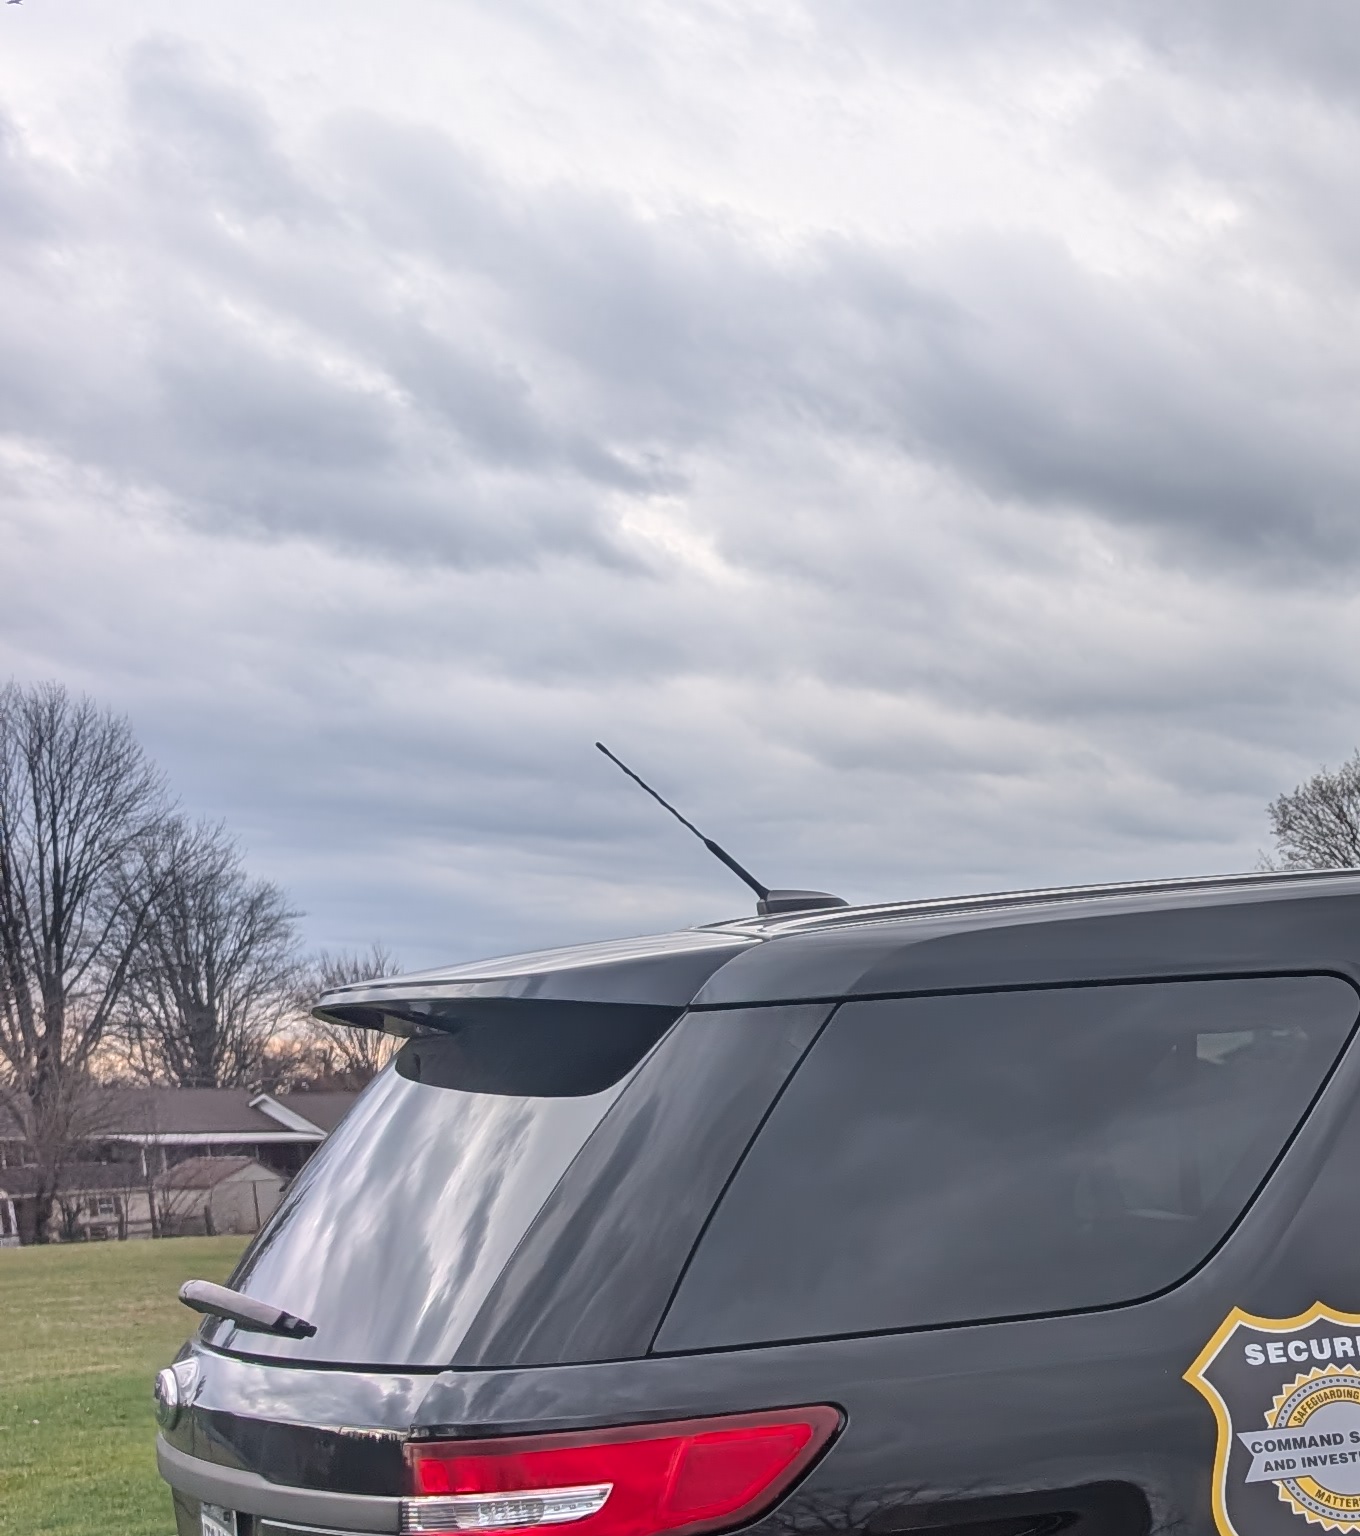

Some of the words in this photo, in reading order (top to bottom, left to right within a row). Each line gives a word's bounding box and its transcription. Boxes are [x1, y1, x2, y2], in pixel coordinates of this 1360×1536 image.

[1292, 1388, 1360, 1425] SAFEGUARDING
[1250, 1432, 1345, 1454] COMMAND
[1263, 1457, 1297, 1473] AND
